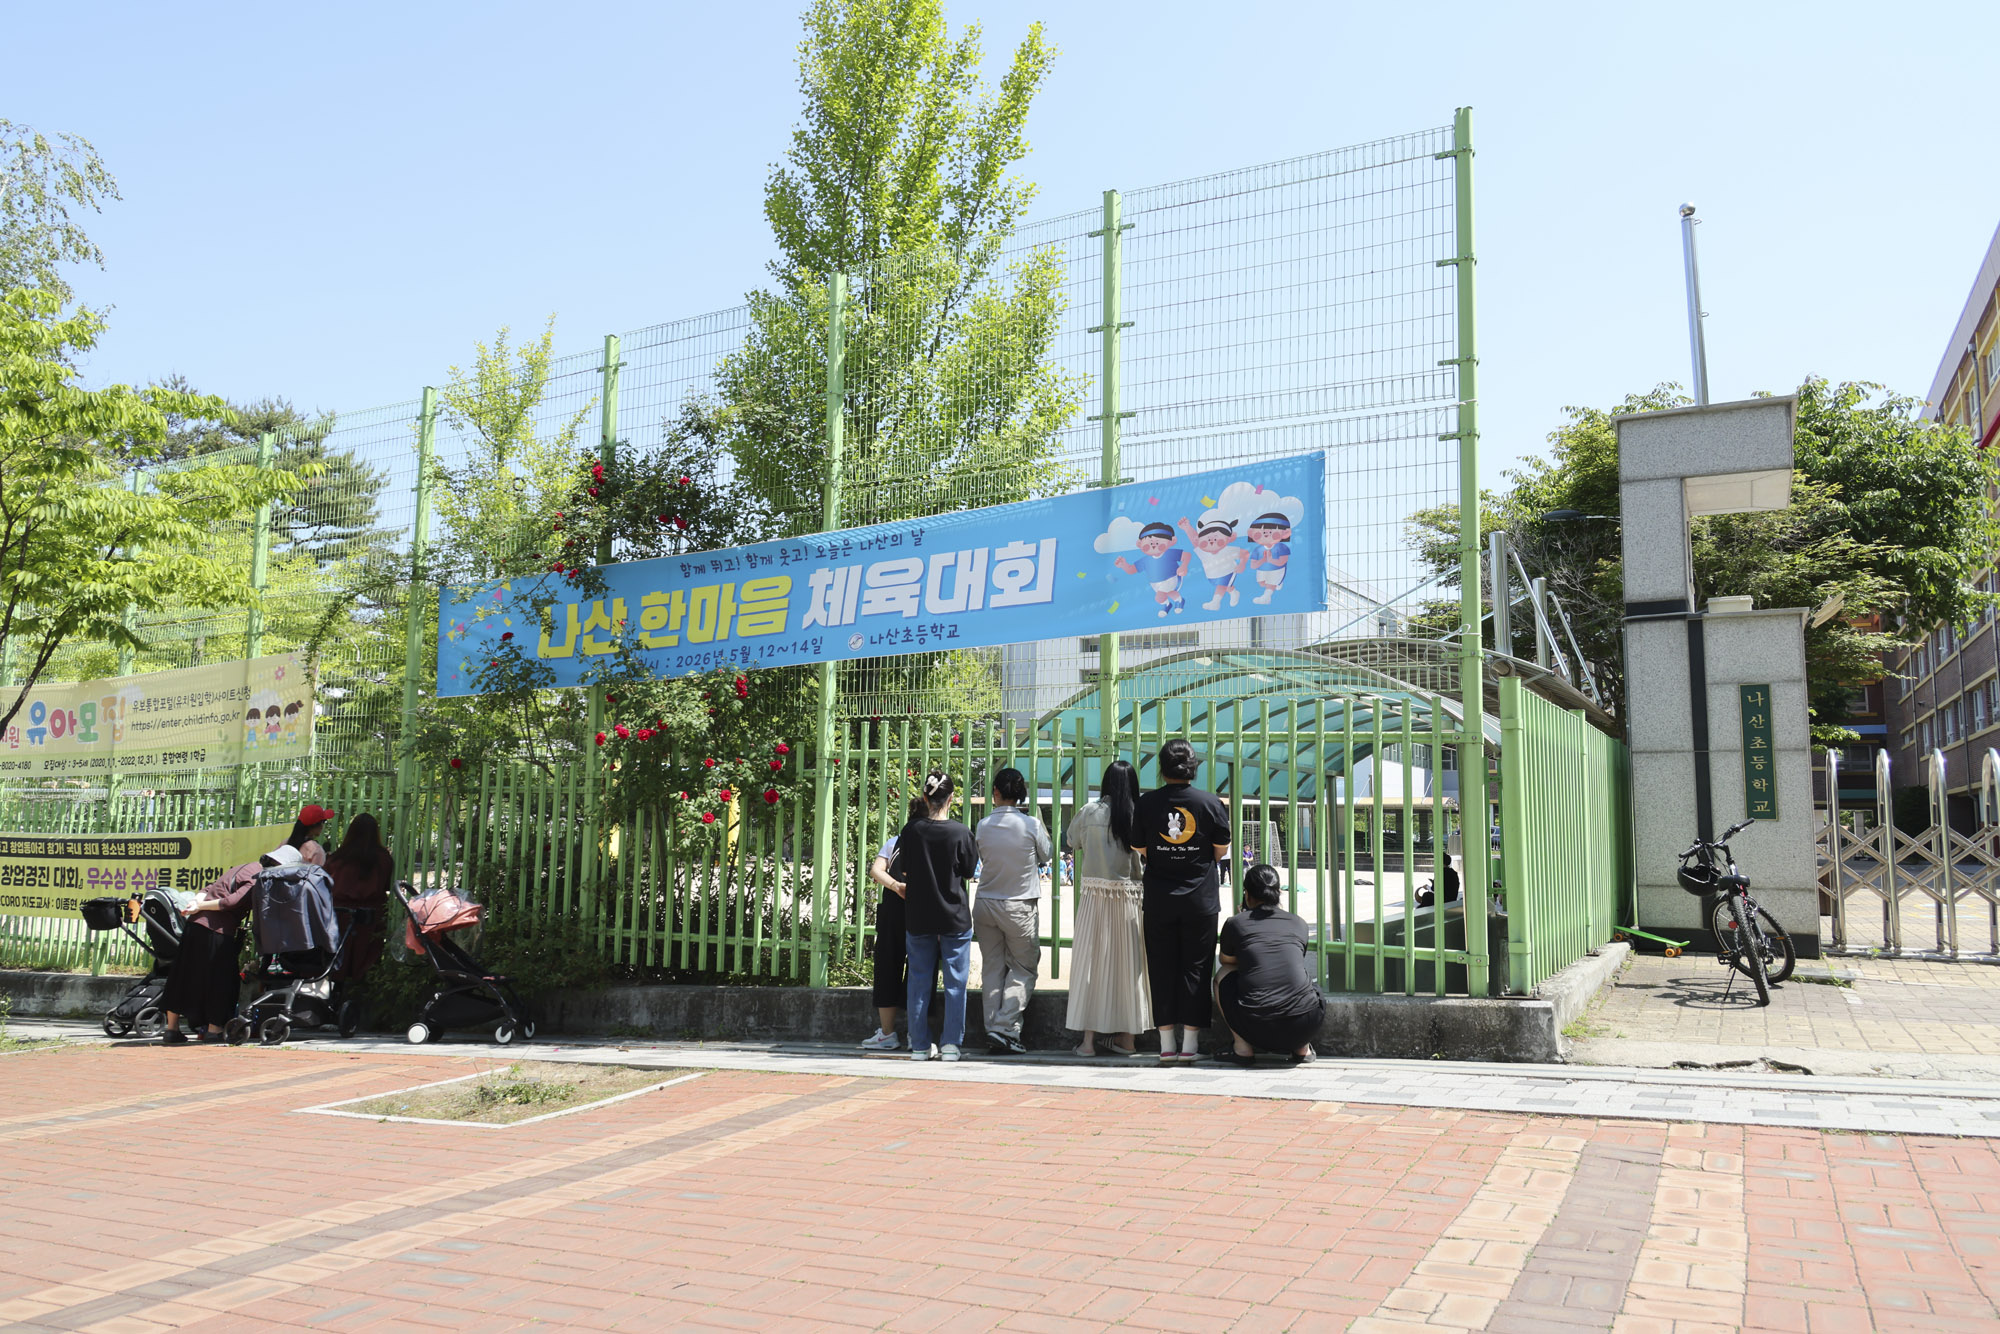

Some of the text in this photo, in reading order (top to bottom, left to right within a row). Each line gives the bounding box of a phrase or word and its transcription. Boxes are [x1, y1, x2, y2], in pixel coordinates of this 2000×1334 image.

[680, 528, 926, 578] 함께 뛰고! 함께 웃고! 오늘은 나산의 날
[537, 538, 1057, 659] 나산 한마음 체육대회
[870, 623, 960, 646] 나산초등학교
[676, 649, 724, 668] 2026년
[729, 645, 751, 664] 5월
[759, 636, 823, 658] 12~14일
[26, 696, 126, 745] 유아모집
[131, 710, 240, 732] https://enter.childinfo.go.kr
[43, 759, 67, 771] 모집대상
[162, 751, 188, 765] 혼합연령
[190, 748, 206, 763] 1학급
[1747, 691, 1771, 812] 나산초등학교
[10, 841, 45, 855] 창업동아리
[47, 842, 64, 855] 참가!
[66, 842, 82, 855] 국내
[83, 842, 100, 855] 최대
[101, 842, 126, 856] 청소년
[127, 842, 180, 856] 창업경진대회!
[1, 864, 50, 887] 창업경진
[86, 867, 128, 890] 우수상
[131, 867, 172, 890] 수상을
[21, 896, 50, 910] 지도교사
